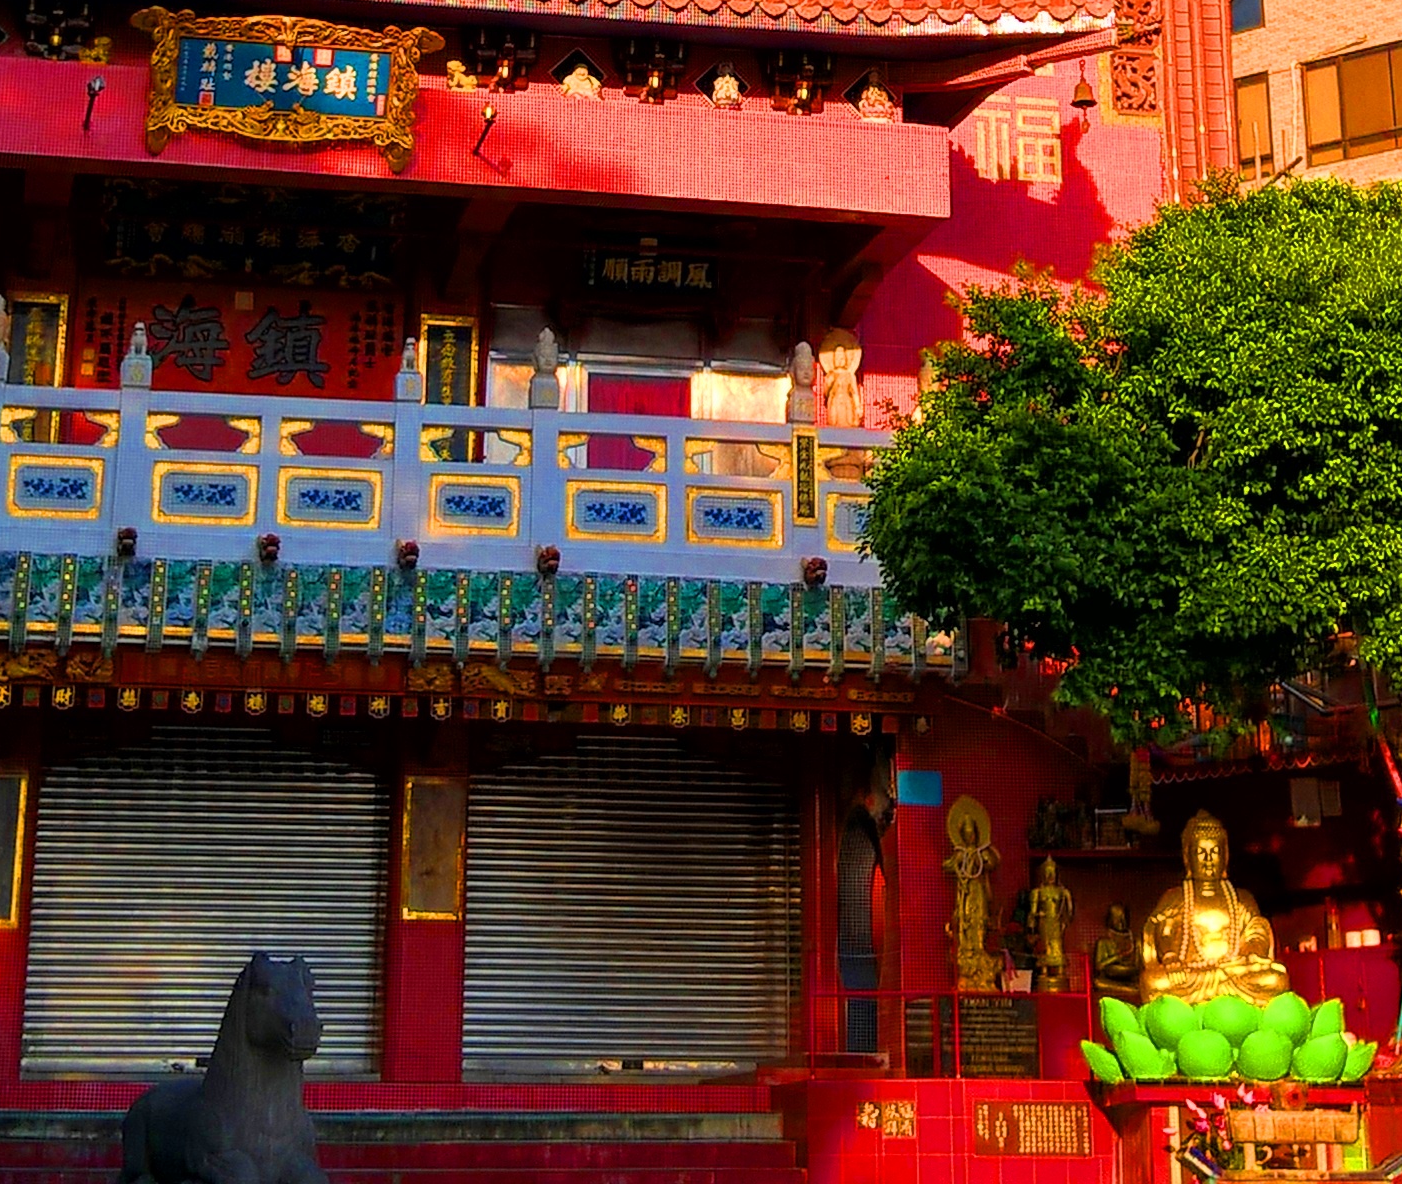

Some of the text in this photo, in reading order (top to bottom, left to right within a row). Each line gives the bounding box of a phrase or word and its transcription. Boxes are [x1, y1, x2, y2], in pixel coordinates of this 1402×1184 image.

[244, 59, 358, 102] 鎮海樓
[973, 94, 1063, 183] 福
[601, 257, 713, 290] 風調雨順
[146, 302, 331, 390] 鎮海
